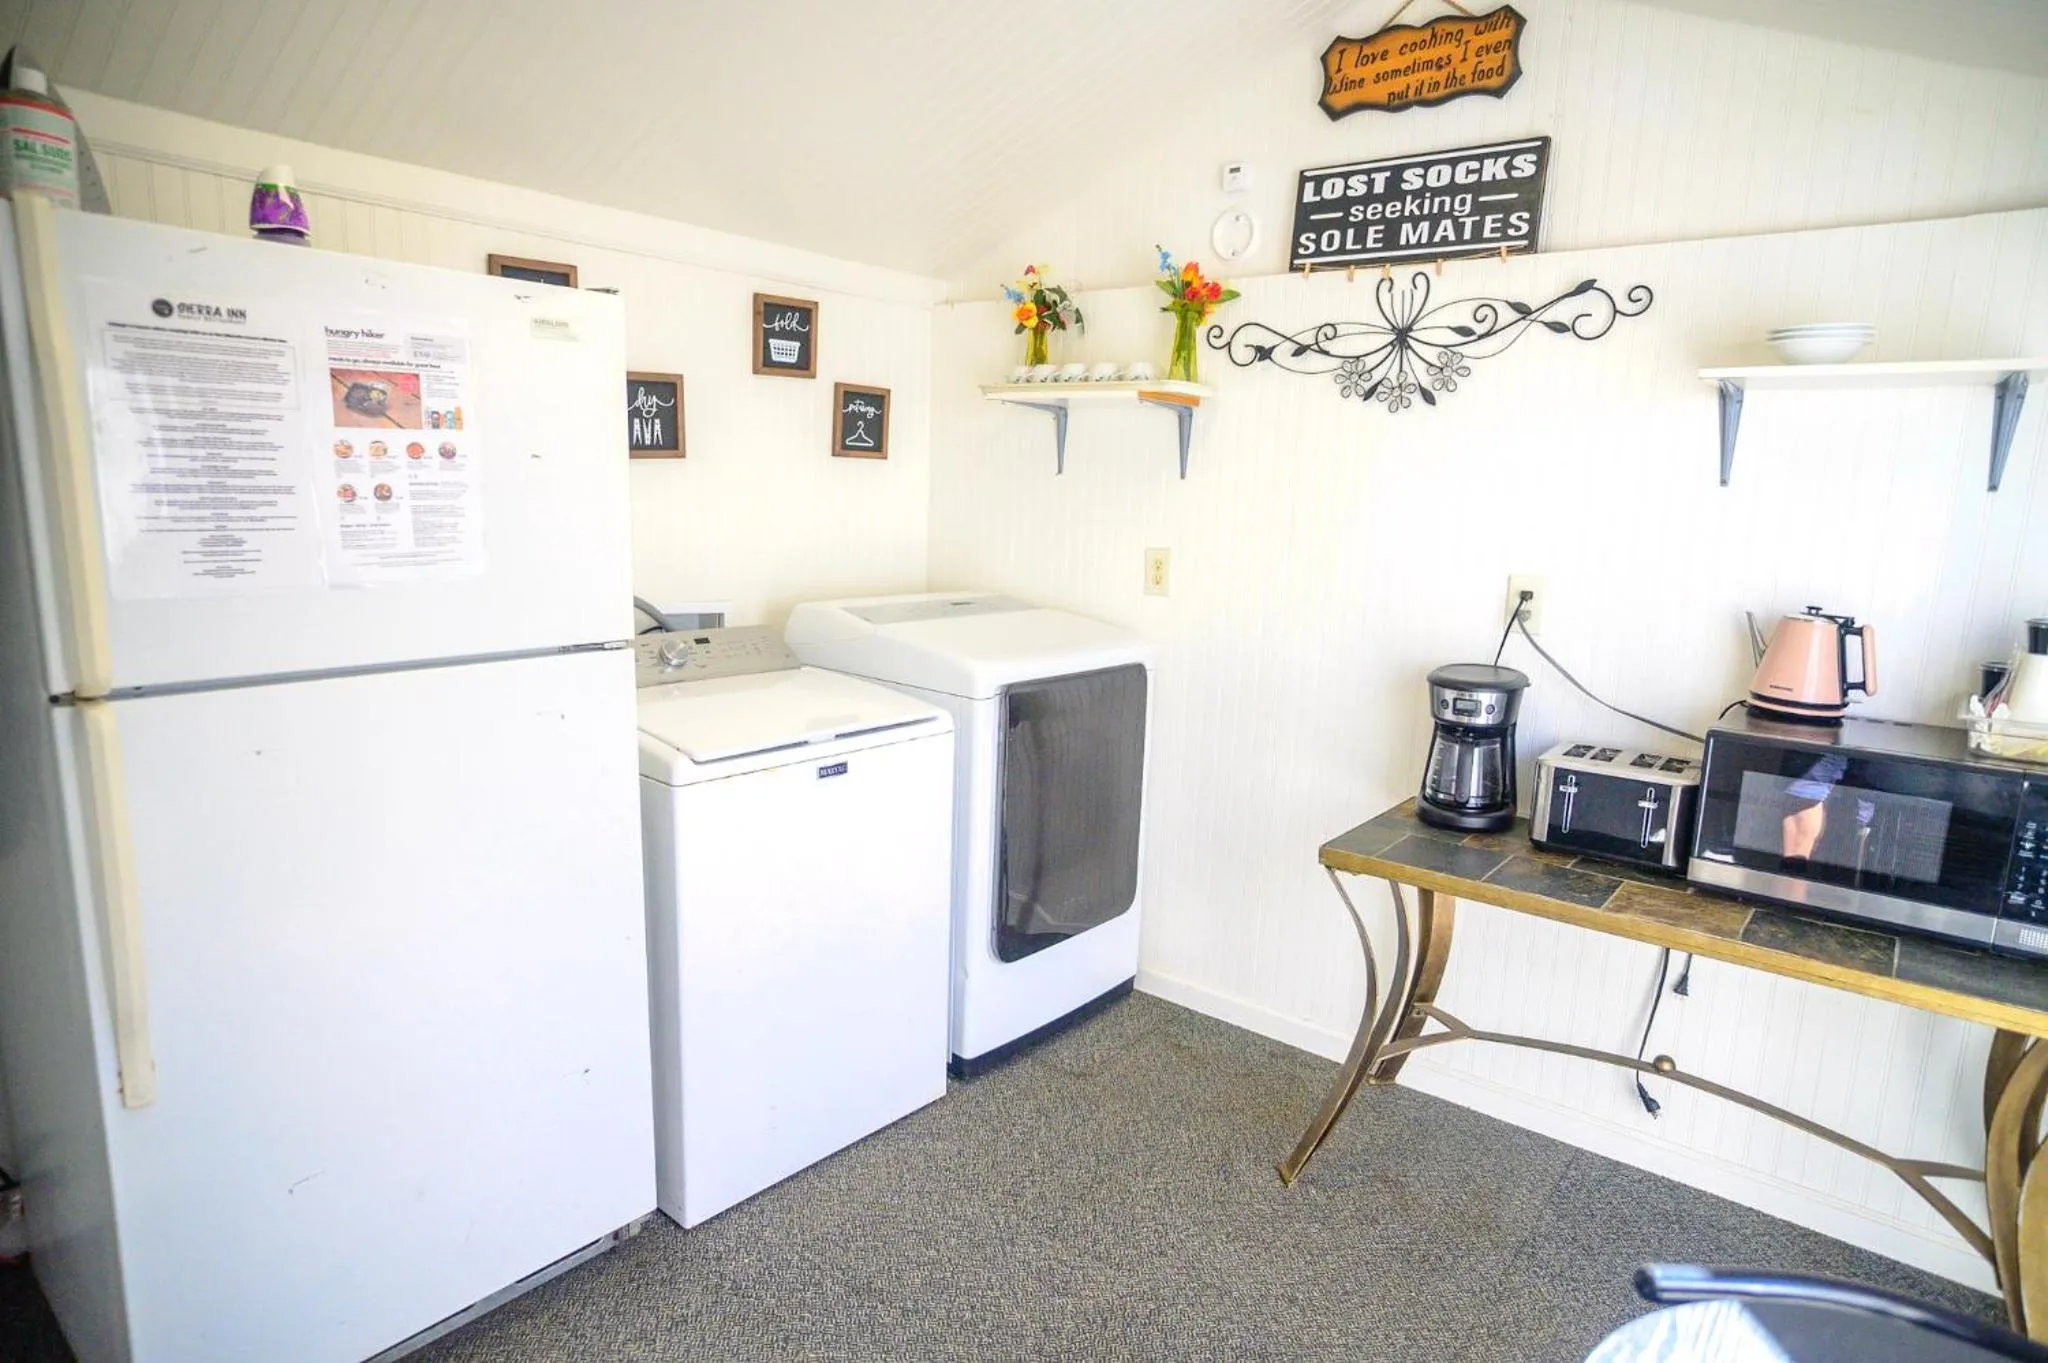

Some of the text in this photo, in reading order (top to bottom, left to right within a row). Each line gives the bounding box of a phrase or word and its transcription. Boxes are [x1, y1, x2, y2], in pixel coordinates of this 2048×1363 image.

[1335, 12, 1512, 74] I love cooking with
[1373, 54, 1452, 84] sometimes
[1460, 40, 1471, 62] I
[1475, 39, 1512, 58] even
[1386, 54, 1507, 106] put it in the food
[1302, 153, 1537, 203] LOST SOCKS
[1348, 192, 1473, 222] seeking
[1298, 211, 1530, 255] SOLE MATES
[324, 326, 360, 339] hungry
[628, 387, 674, 417] dry
